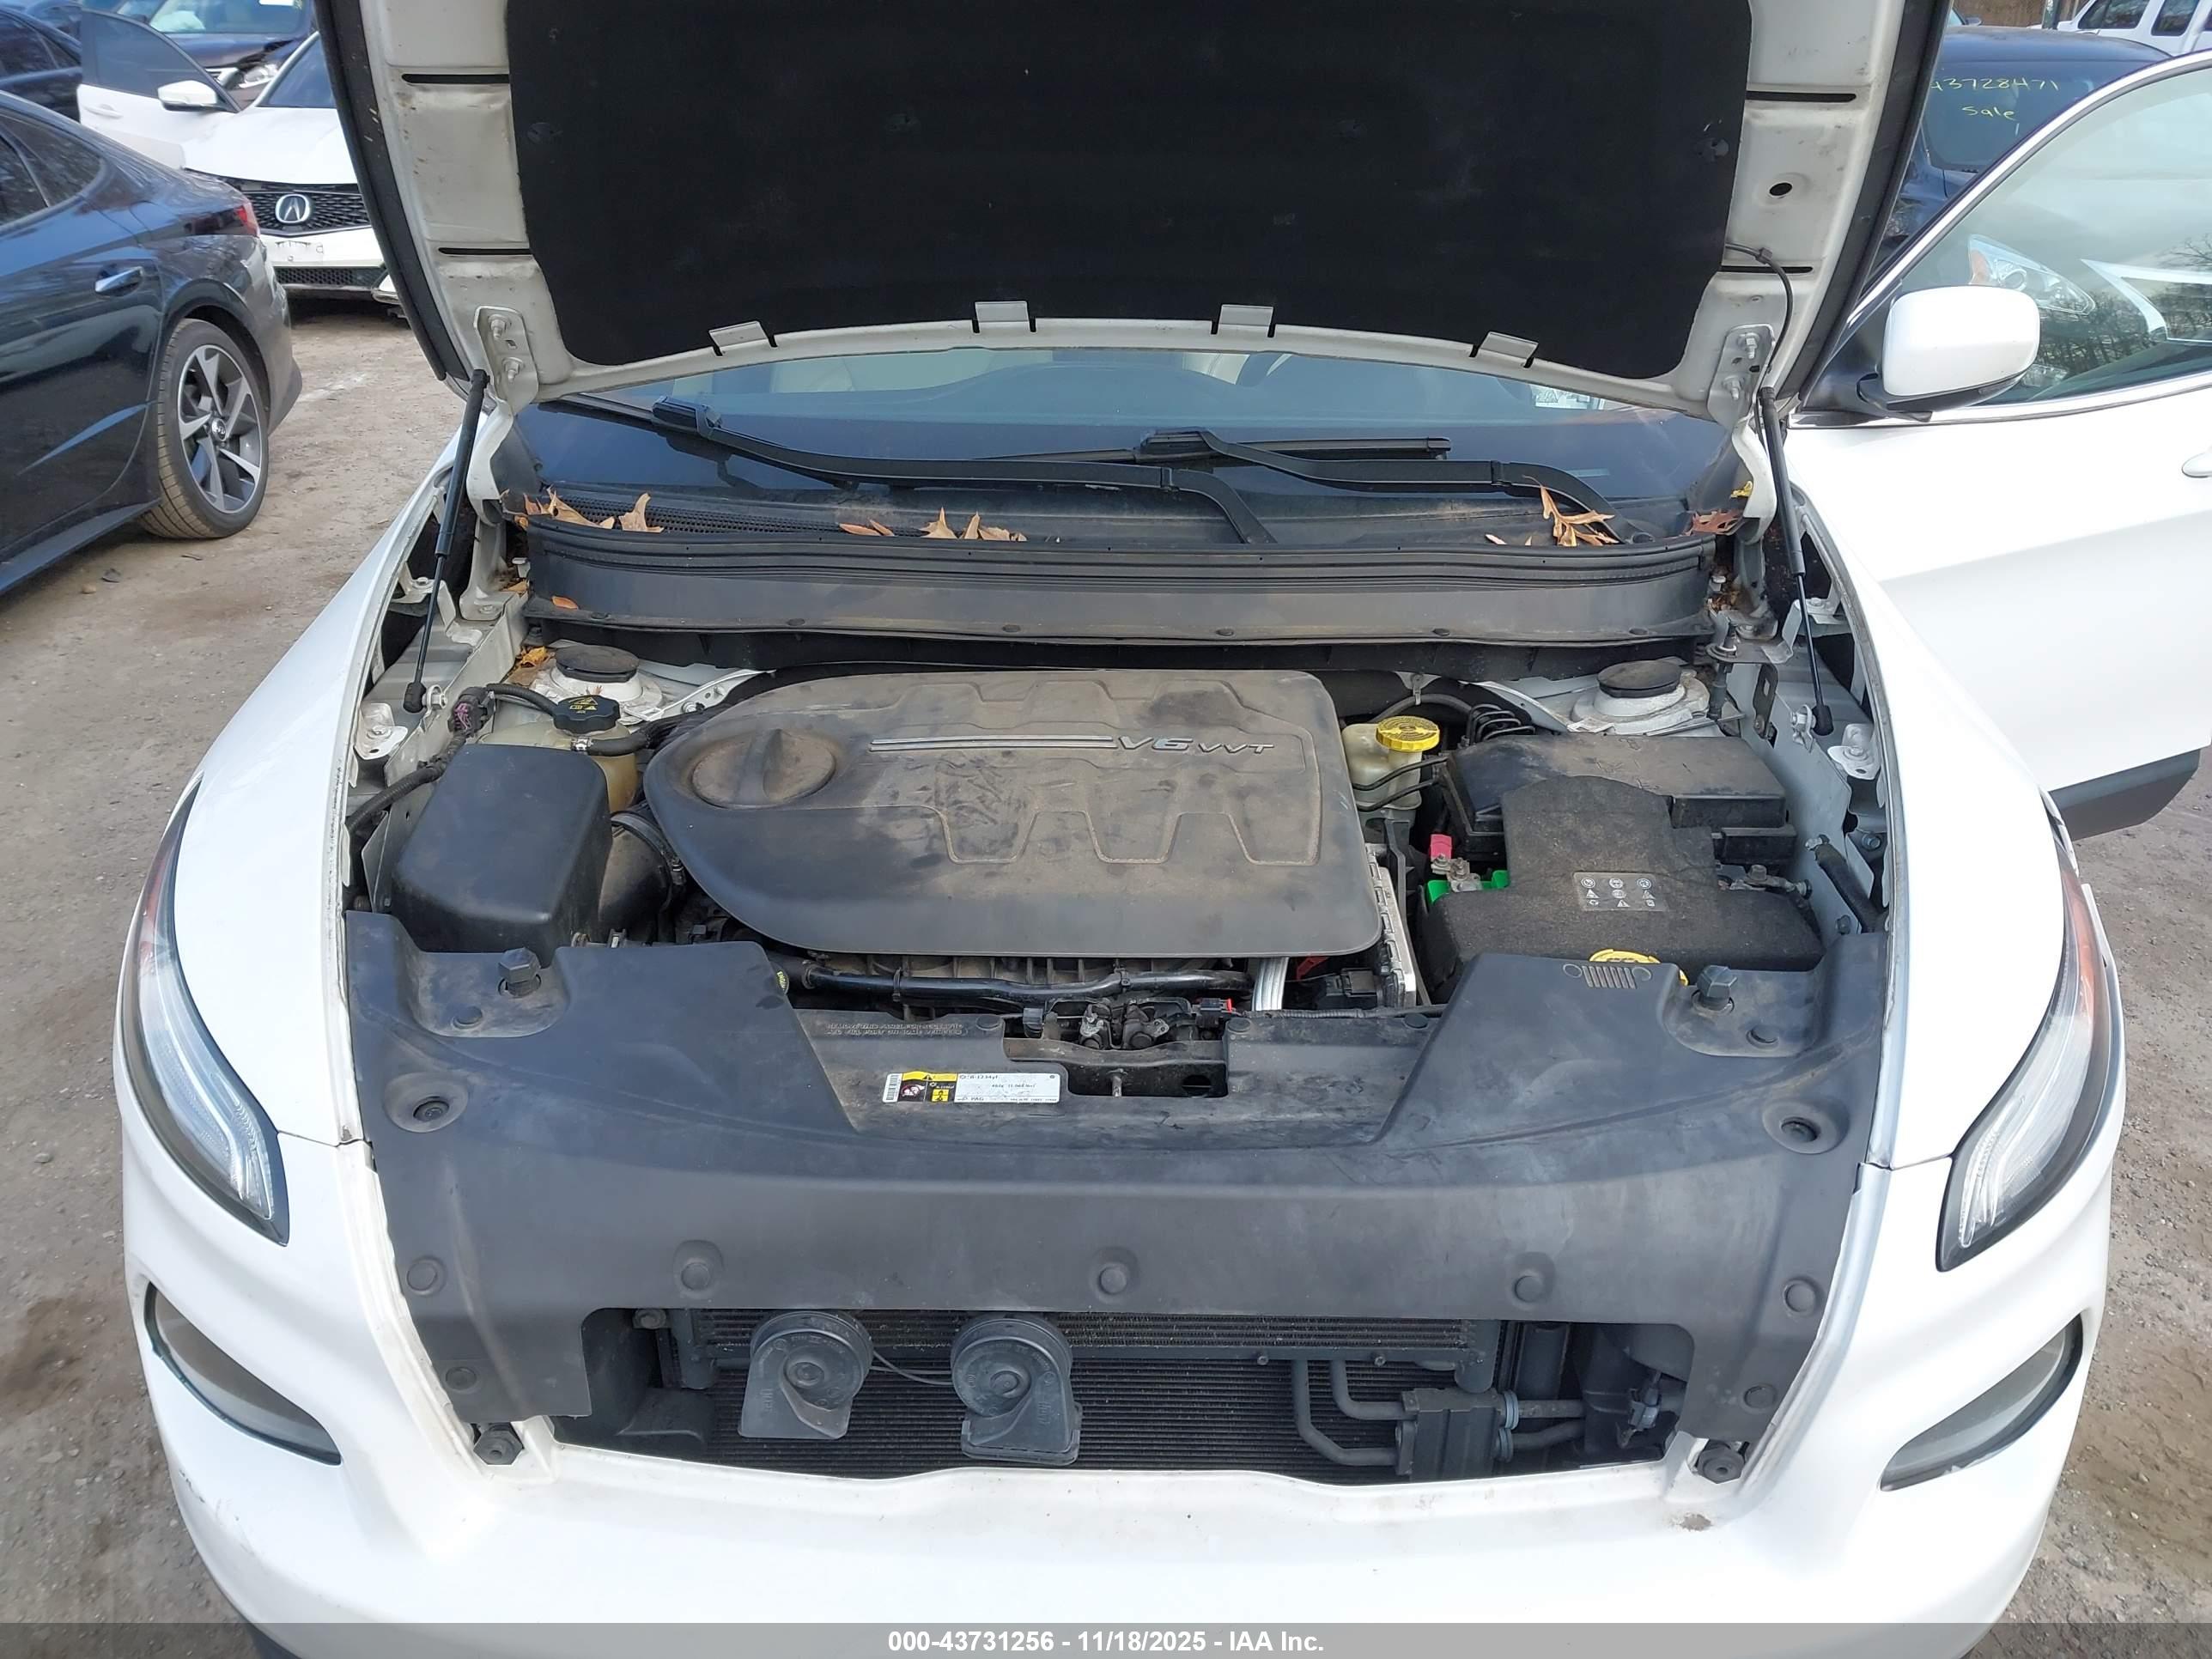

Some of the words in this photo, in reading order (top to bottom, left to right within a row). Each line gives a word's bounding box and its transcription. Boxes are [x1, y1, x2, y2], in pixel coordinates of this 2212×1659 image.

[1961, 106, 2017, 121] Sale
[1118, 736, 1194, 750] V6
[1198, 738, 1275, 755] VVT
